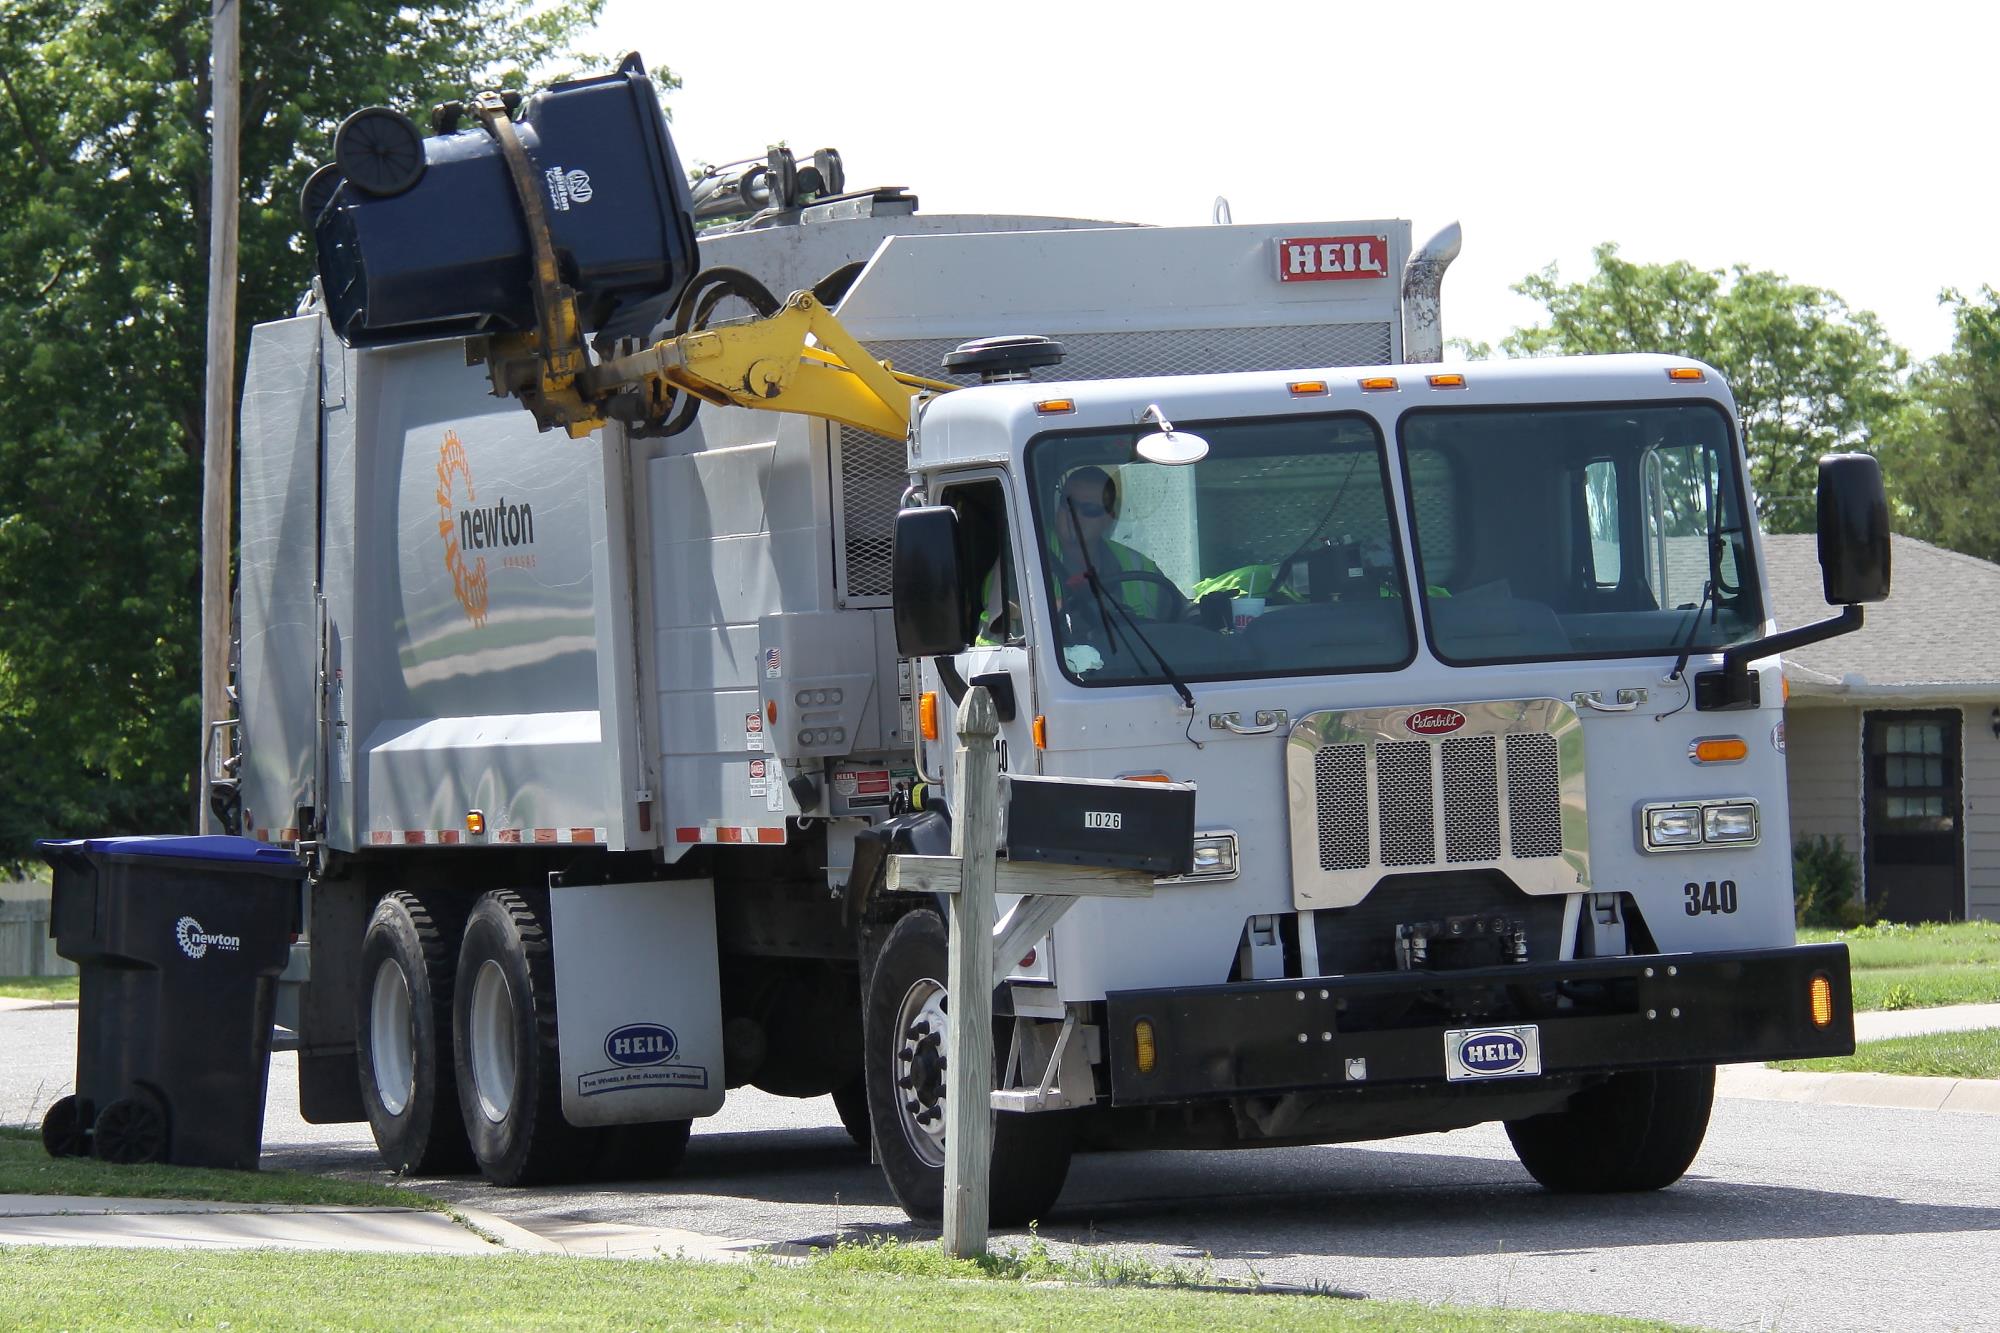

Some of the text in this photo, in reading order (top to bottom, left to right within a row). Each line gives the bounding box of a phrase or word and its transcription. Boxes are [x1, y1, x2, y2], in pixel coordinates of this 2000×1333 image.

[1288, 242, 1382, 274] HEIL
[460, 496, 535, 551] newton
[1412, 714, 1461, 730] Peterbilt
[1088, 812, 1120, 829] 1026
[1684, 880, 1738, 916] 340
[191, 933, 240, 946] newton
[614, 1035, 670, 1055] HEIL
[1468, 1043, 1520, 1063] HEIL
